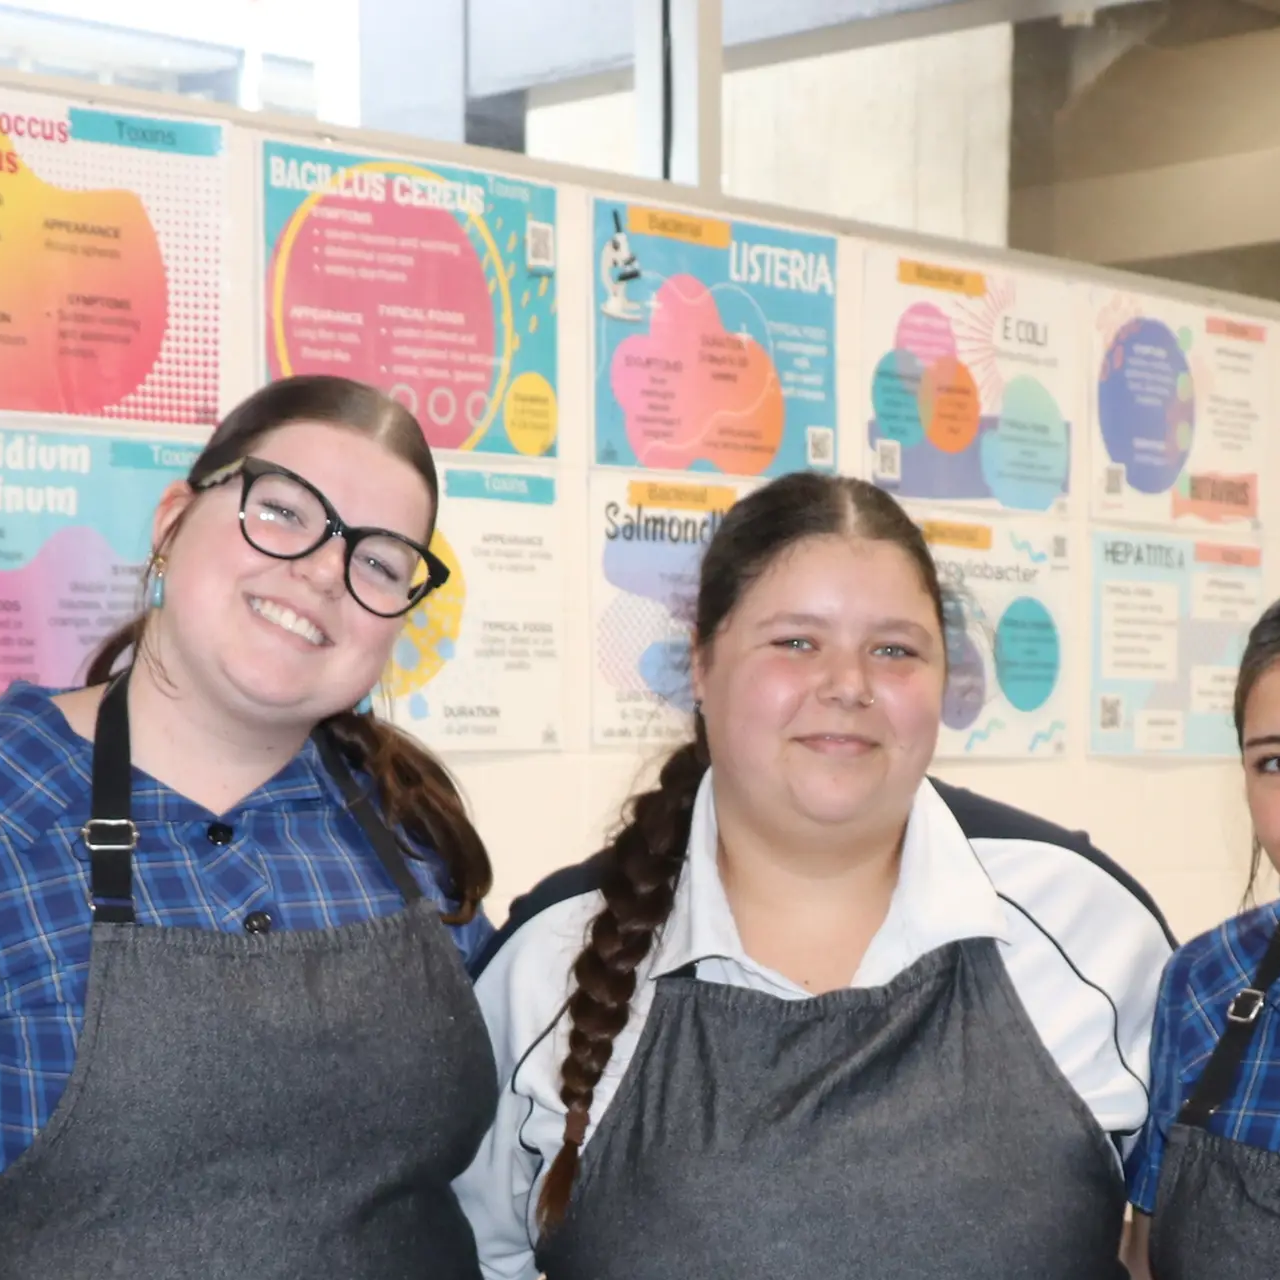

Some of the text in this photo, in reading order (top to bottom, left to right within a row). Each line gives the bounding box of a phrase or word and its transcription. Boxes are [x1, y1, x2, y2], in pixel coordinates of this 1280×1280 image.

[114, 120, 177, 147] Toxins
[269, 154, 486, 216] BACILLUS CEREUS
[485, 175, 531, 203] Toxins
[43, 218, 121, 240] APPEARANCE
[728, 239, 836, 296] LISTERIA
[289, 304, 365, 327] APPEARANCE
[377, 304, 425, 322] TYPICAL
[1003, 315, 1049, 348] E COLI
[482, 470, 529, 494] Toxins
[604, 500, 729, 545] Salmonell
[1103, 539, 1174, 569] HEPATITIS
